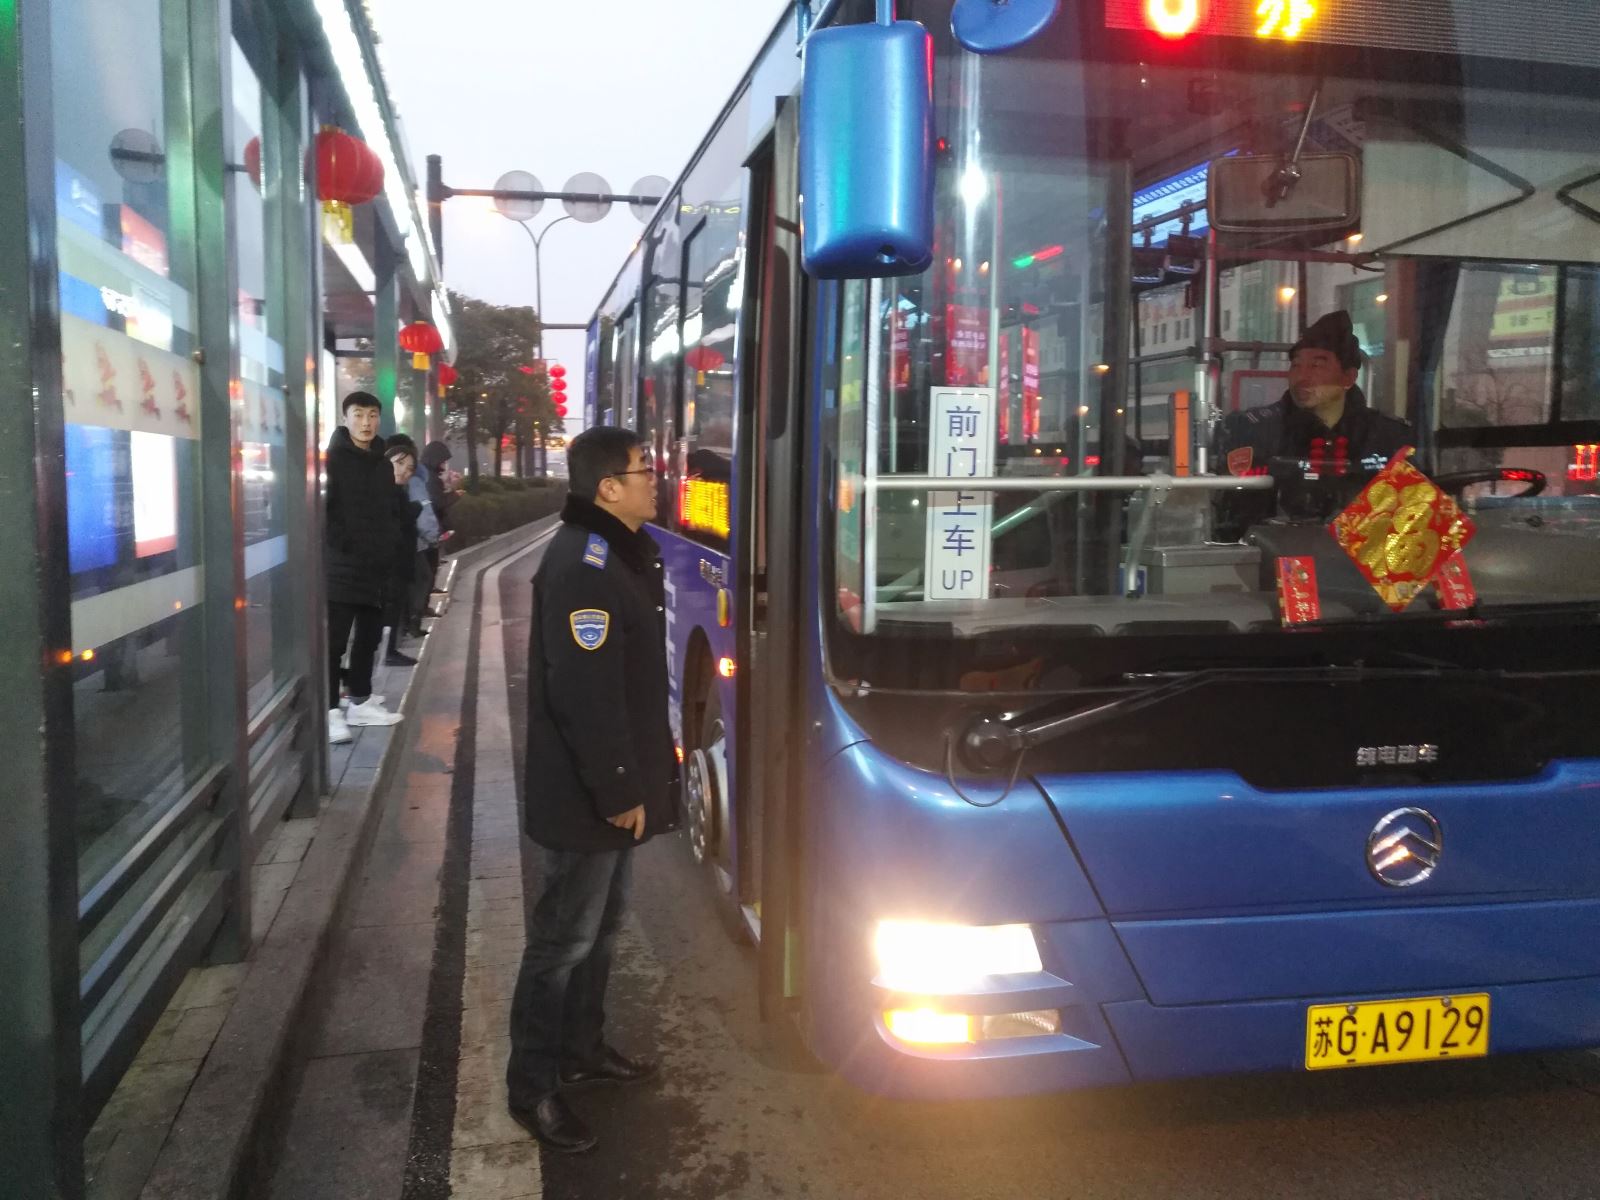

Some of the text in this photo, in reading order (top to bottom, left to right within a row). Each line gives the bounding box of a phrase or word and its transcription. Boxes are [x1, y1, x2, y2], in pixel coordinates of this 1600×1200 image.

[942, 405, 981, 557] 前门上车
[942, 569, 974, 591] UP
